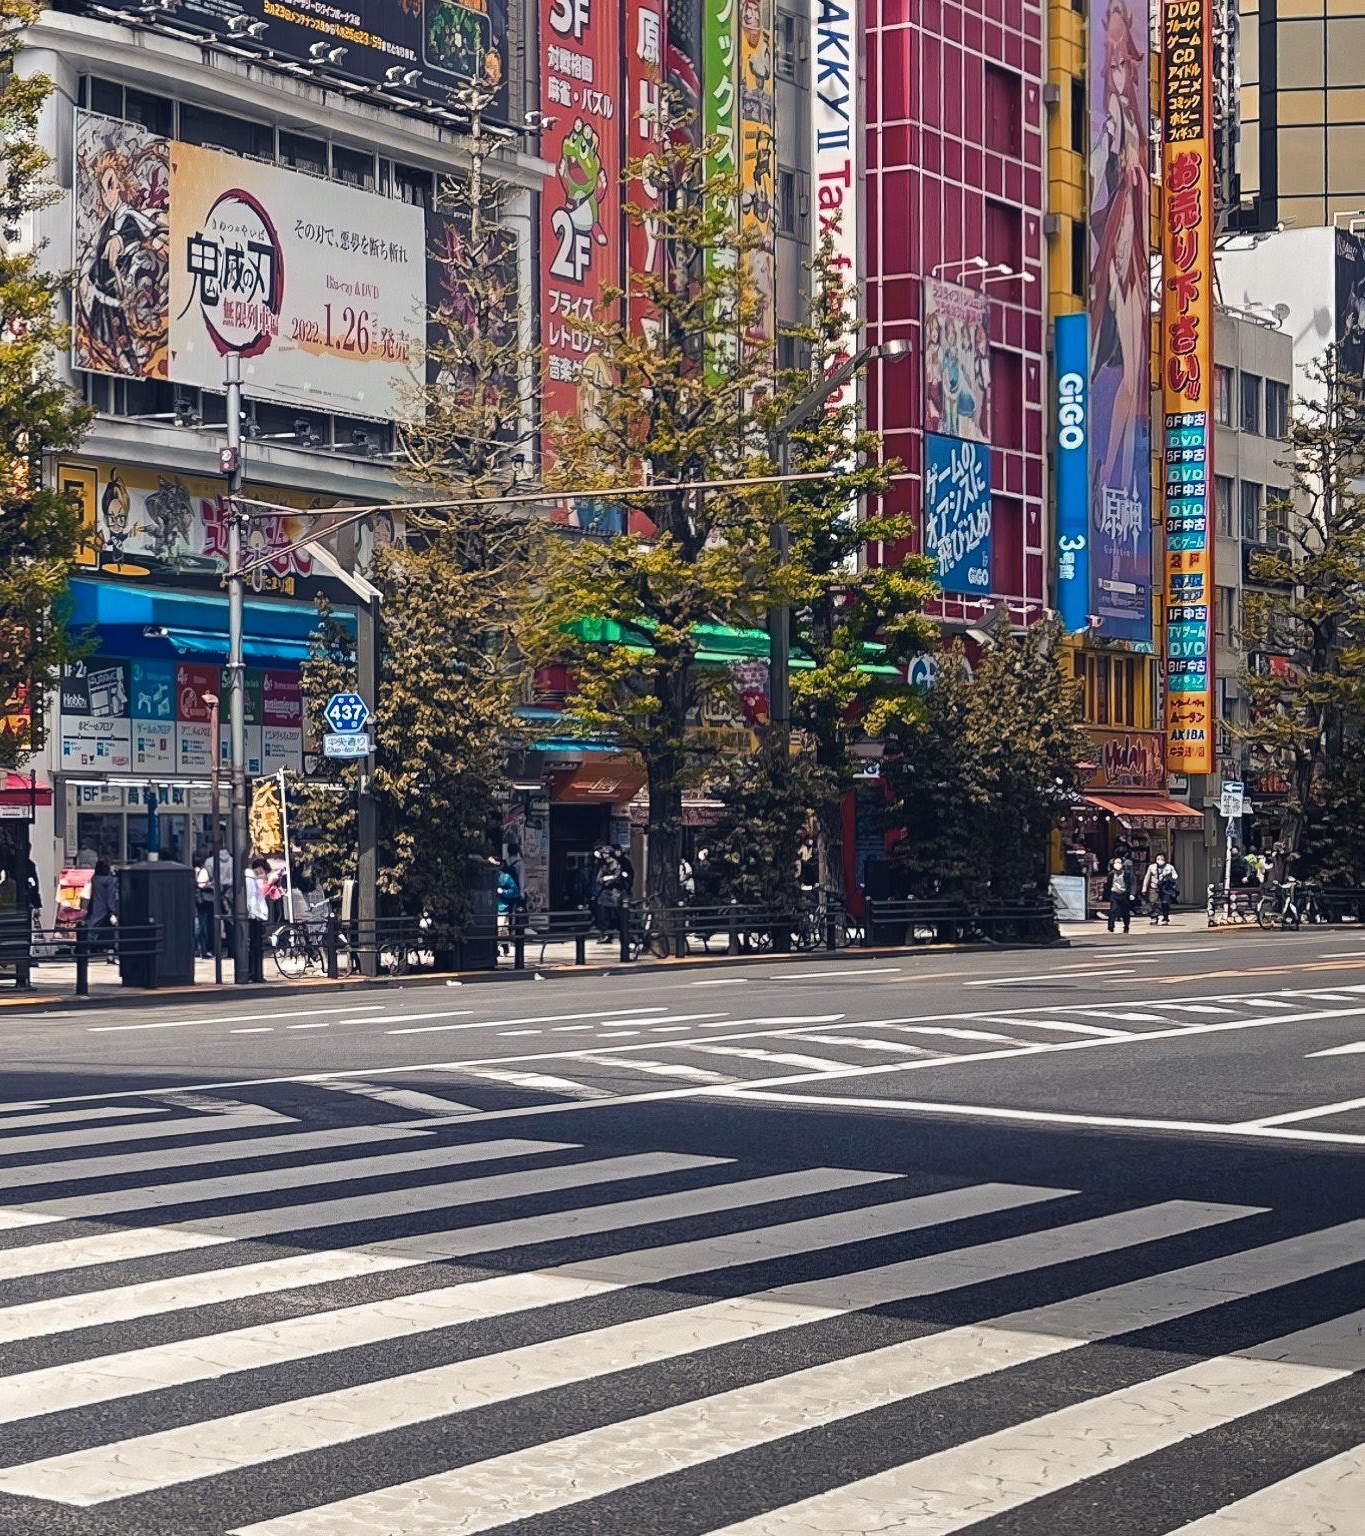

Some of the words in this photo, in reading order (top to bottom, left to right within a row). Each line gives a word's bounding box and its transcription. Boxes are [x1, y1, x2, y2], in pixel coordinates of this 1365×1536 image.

[1168, 0, 1201, 20] DVD
[1167, 32, 1202, 49] ゲーム
[1172, 48, 1196, 64] CD
[1167, 63, 1201, 80] アイドル
[1167, 78, 1202, 95] アニメ
[1169, 94, 1201, 110] コミック
[1169, 111, 1200, 126] ホビー
[1168, 124, 1201, 142] フィギュア
[818, 159, 852, 237] Tax
[550, 208, 592, 282] 2F
[175, 232, 279, 322] 鬼滅の刃
[1058, 372, 1084, 450] GiGO
[1165, 413, 1206, 428] 6F中古
[1166, 448, 1206, 463] 5F中古
[1166, 482, 1206, 497] 4F中古
[1166, 517, 1206, 532] 3F中古
[1170, 641, 1206, 657] DVD
[329, 704, 363, 721] 437
[1170, 728, 1206, 742] AKIBA
